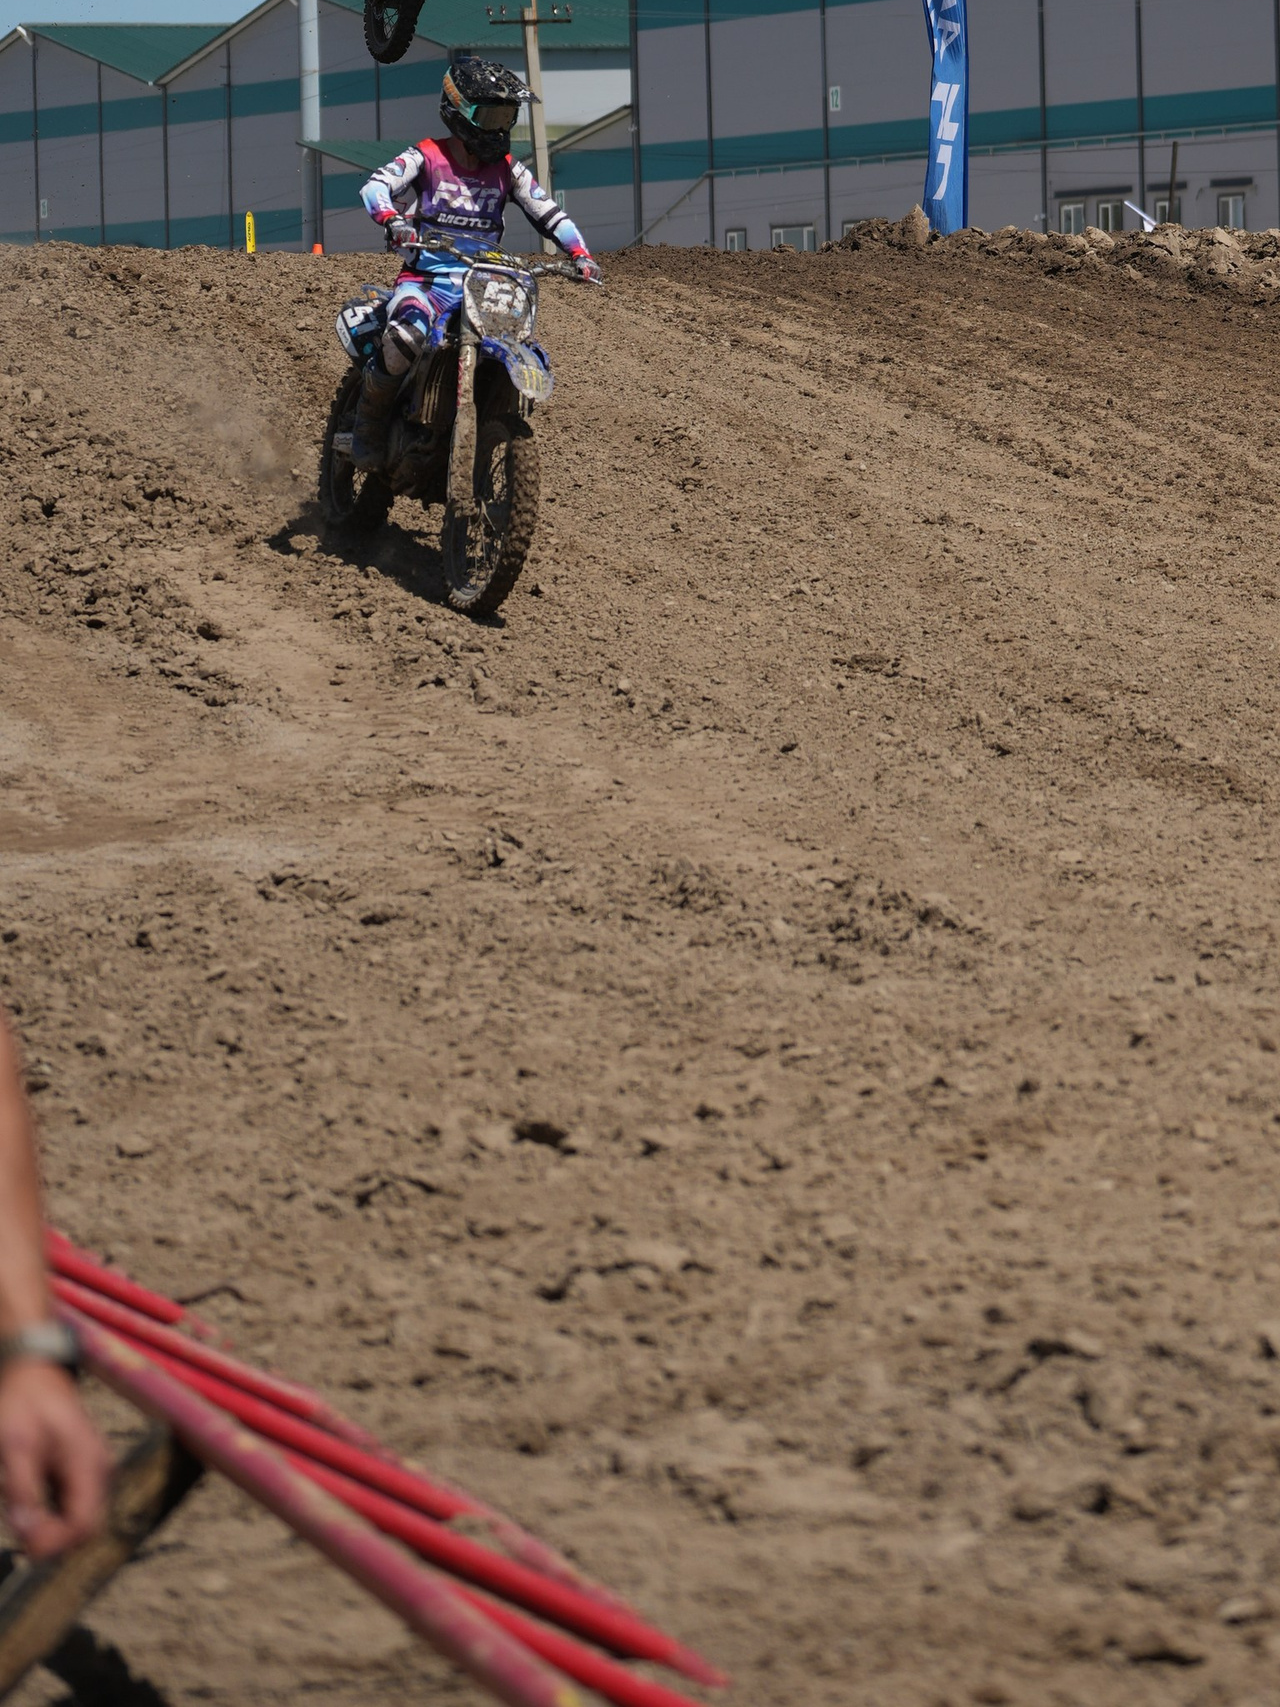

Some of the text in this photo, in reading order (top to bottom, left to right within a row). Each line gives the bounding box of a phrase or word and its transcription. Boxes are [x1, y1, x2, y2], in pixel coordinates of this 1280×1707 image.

[831, 89, 839, 108] 12
[431, 180, 501, 212] FXR
[437, 212, 492, 229] MOTO
